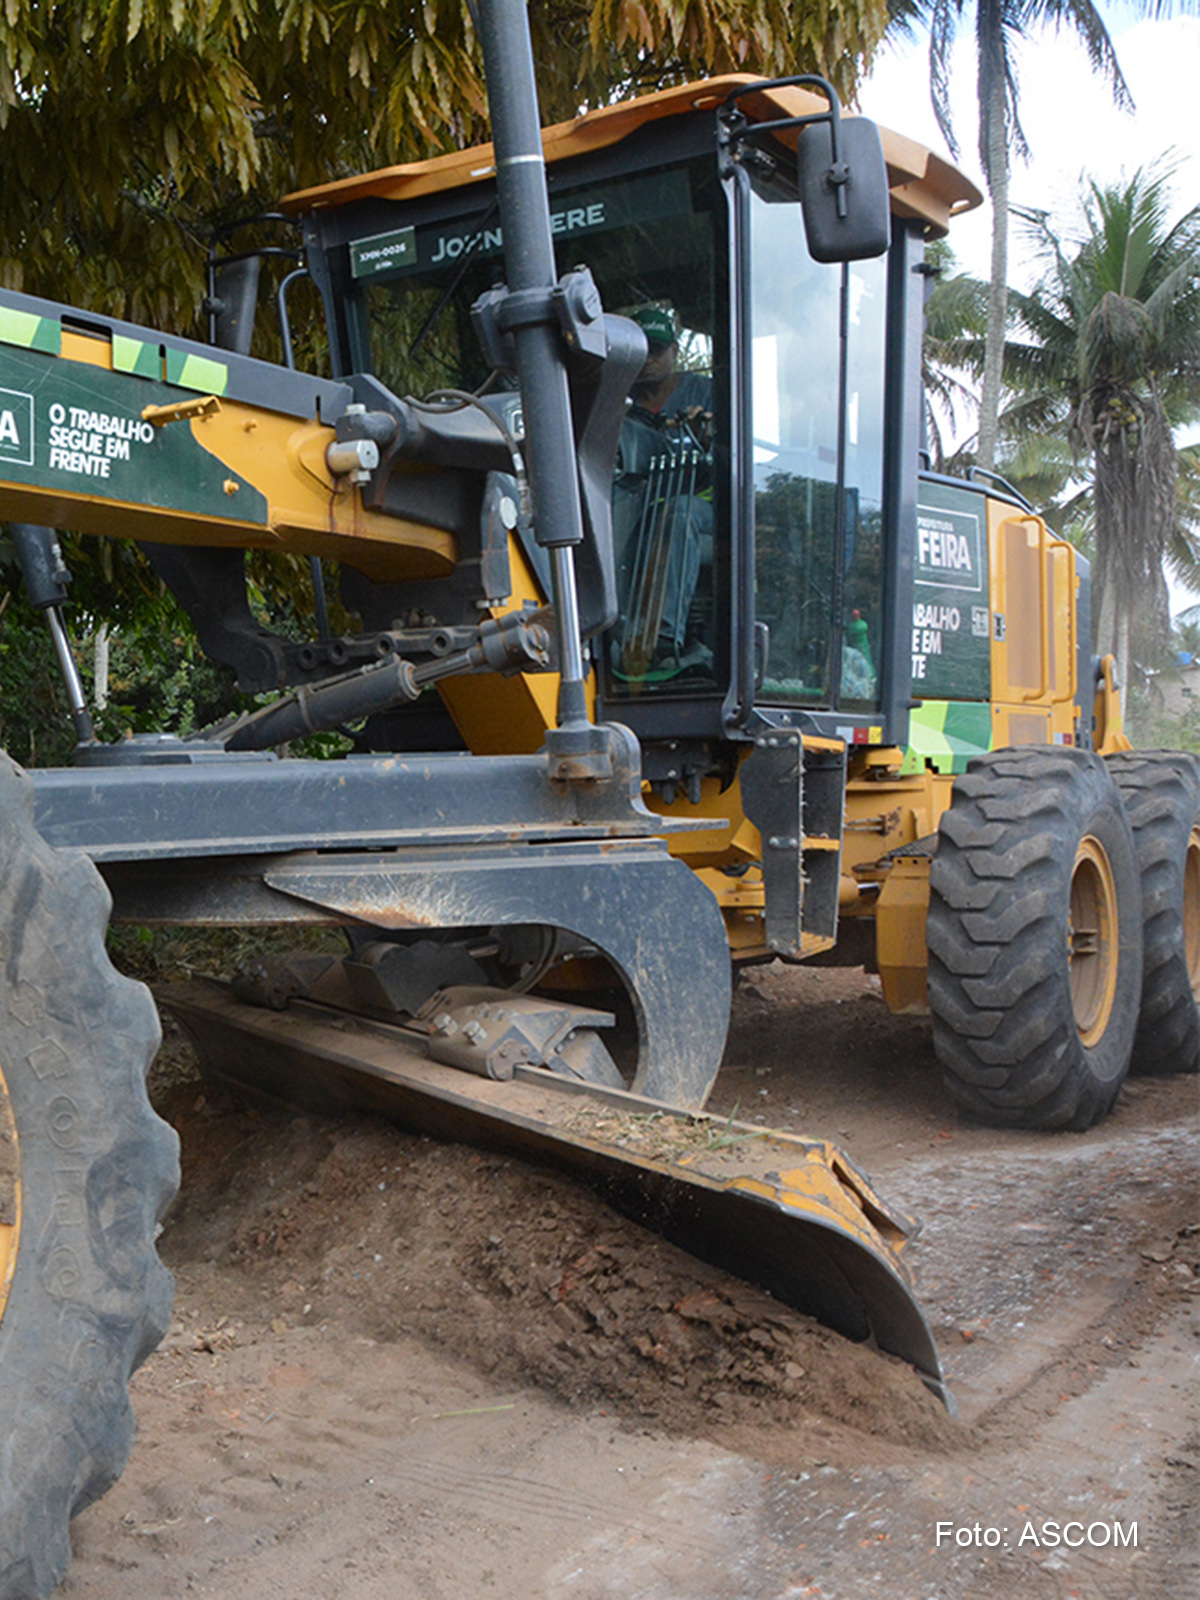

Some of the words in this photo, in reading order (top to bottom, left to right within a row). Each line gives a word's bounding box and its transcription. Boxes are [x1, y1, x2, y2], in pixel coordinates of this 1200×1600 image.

[549, 203, 606, 234] ERE
[49, 403, 66, 426] O
[69, 407, 155, 445] TRABALHO
[48, 425, 103, 453] SEGUE
[104, 440, 131, 461] EM
[49, 447, 111, 478] FRENTE
[917, 528, 973, 572] FEIRA
[913, 603, 962, 632] BALHO
[922, 630, 943, 655] EM
